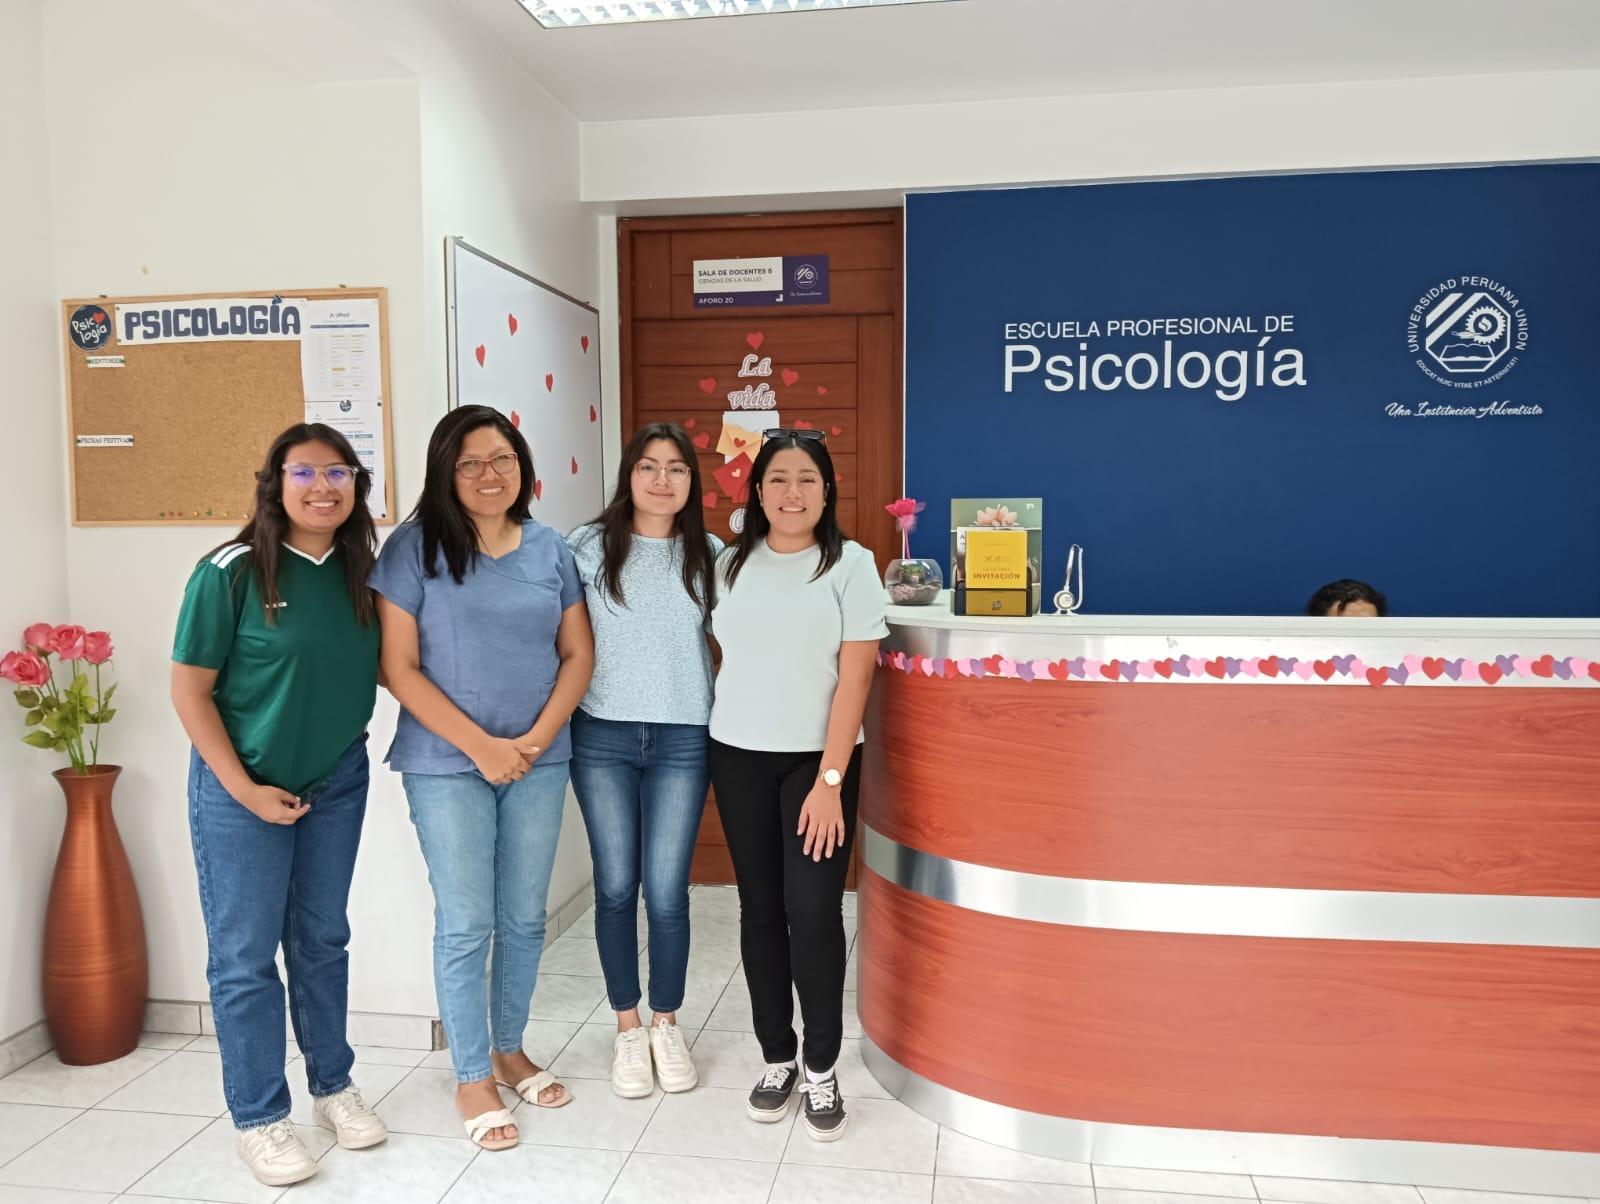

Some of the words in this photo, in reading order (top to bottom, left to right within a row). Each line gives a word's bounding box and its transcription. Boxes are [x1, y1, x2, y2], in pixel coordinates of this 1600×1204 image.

[729, 268, 766, 276] DOCENTES
[124, 295, 300, 340] PSICOLOGÍA
[1408, 279, 1457, 353] UNIVERSIDAD
[1461, 276, 1519, 308] PERUANA
[1005, 321, 1100, 339] ESCUELA
[1107, 317, 1258, 336] PROFESIONAL
[1264, 315, 1294, 332] DE
[738, 353, 773, 377] La
[1004, 336, 1307, 401] Psicología
[727, 383, 777, 410] vida
[1385, 402, 1412, 417] Una
[1476, 400, 1543, 418] Adventista
[973, 571, 1020, 580] INVITACIÓN
